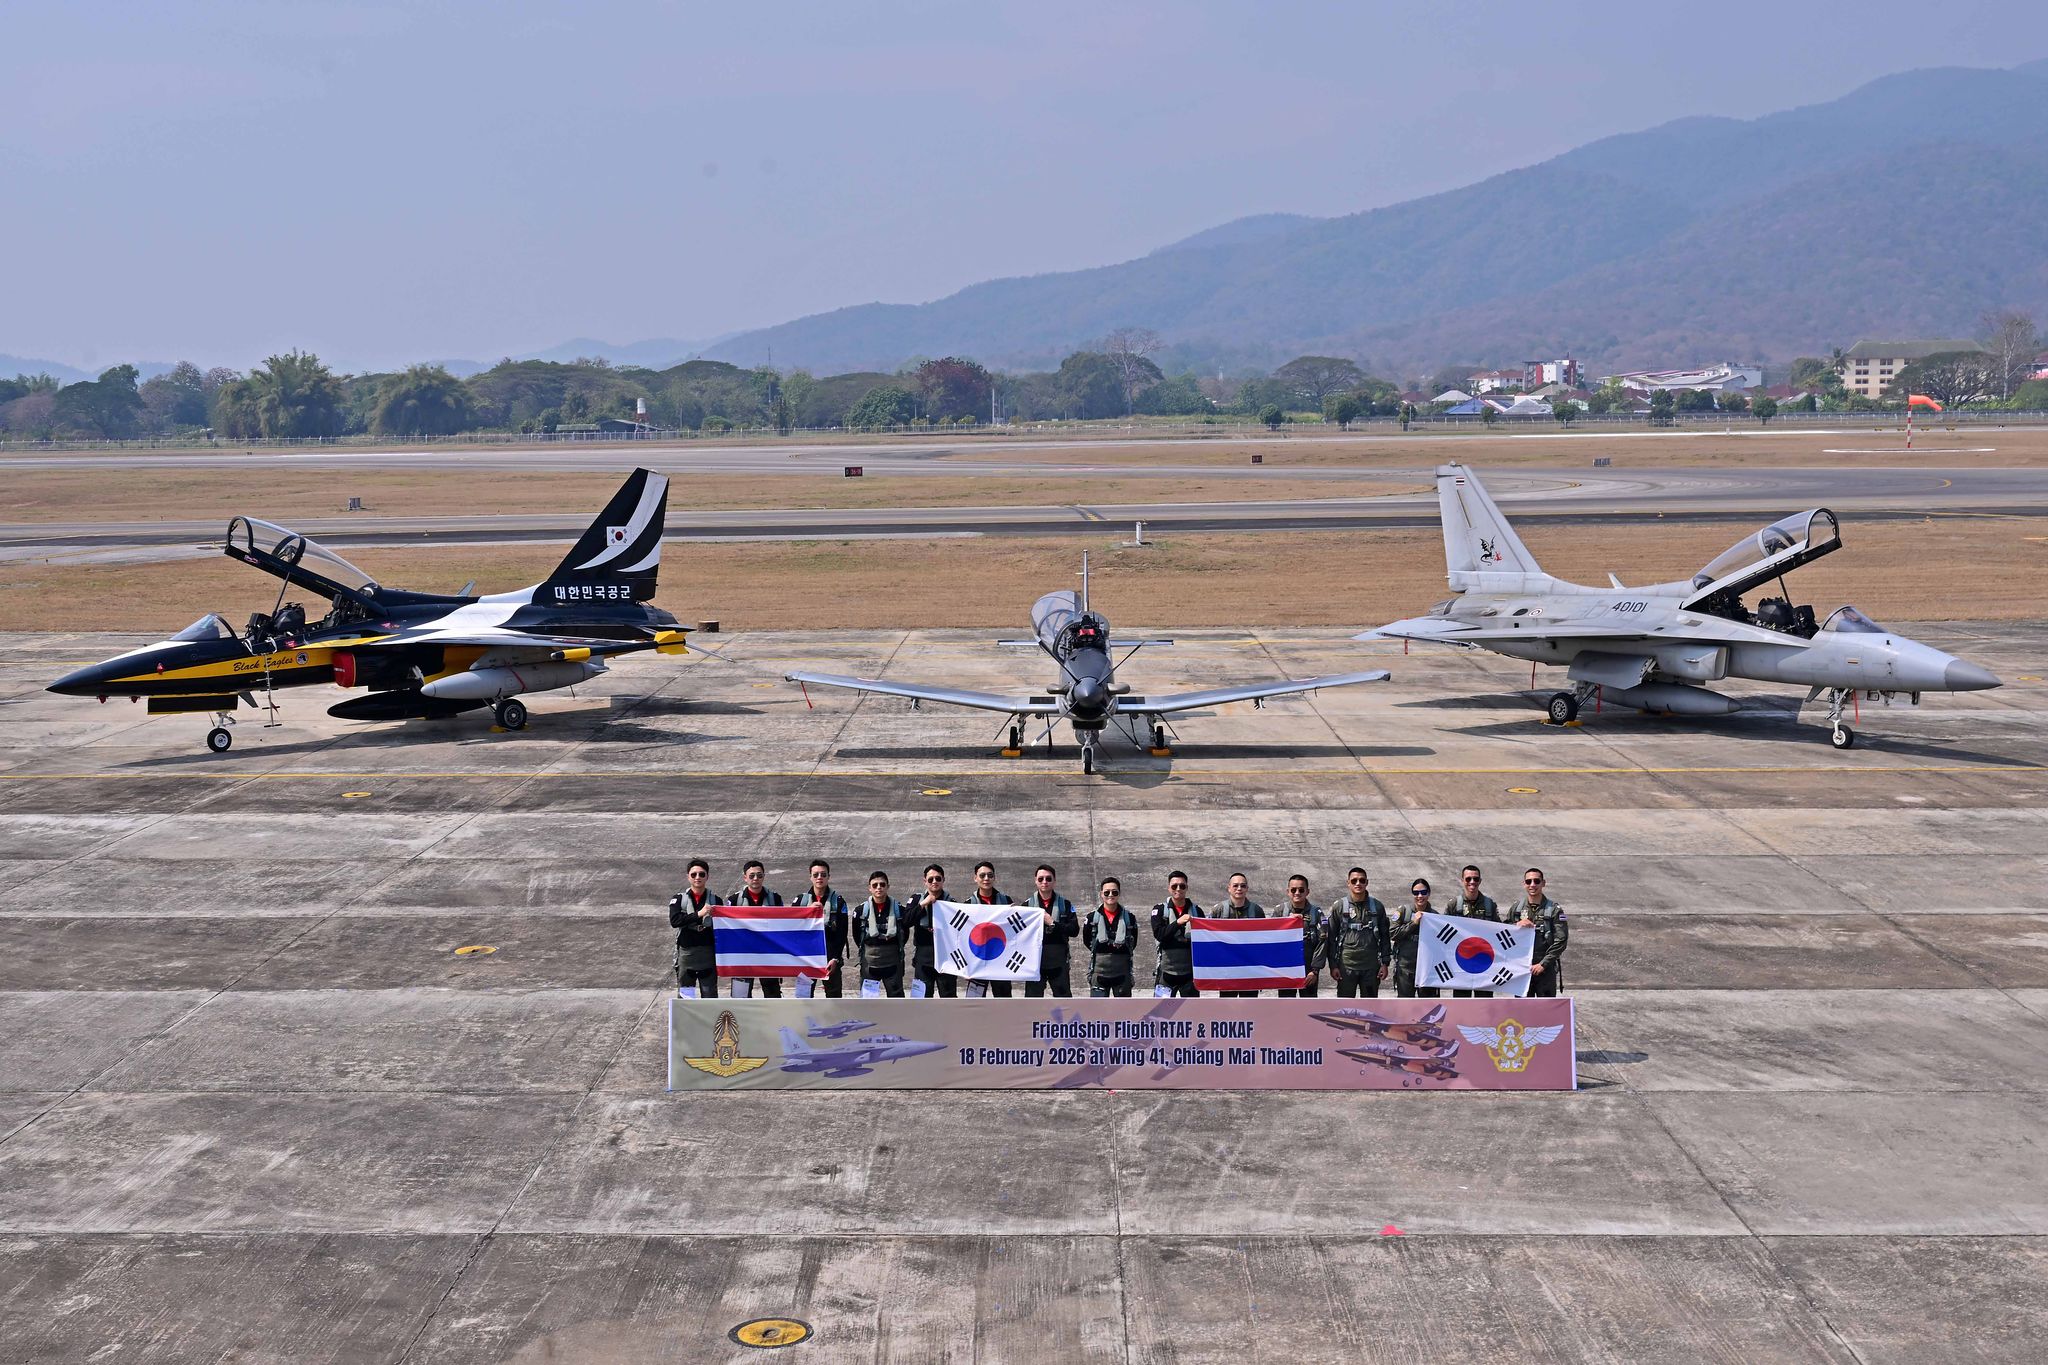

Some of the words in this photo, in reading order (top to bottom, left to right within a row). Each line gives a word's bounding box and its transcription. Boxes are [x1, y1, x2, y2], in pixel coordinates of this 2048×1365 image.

[554, 585, 631, 600] 대한민국공군
[1612, 601, 1648, 613] 40101
[233, 659, 260, 672] Black
[263, 657, 294, 669] Eagles
[1032, 1020, 1110, 1042] Friendship
[1114, 1020, 1156, 1043] Flight
[1160, 1021, 1193, 1039] RTAF
[1196, 1022, 1206, 1039] &
[1210, 1021, 1254, 1039] ROKAF
[959, 1047, 975, 1065] 18
[979, 1047, 1045, 1068] February
[1048, 1047, 1086, 1065] 2026
[1088, 1048, 1105, 1066] at
[1108, 1046, 1145, 1068] Wing
[1149, 1047, 1169, 1067] 41,
[1173, 1046, 1224, 1068] Chiang
[1228, 1046, 1256, 1065] Mai
[1259, 1046, 1323, 1065] Thailand
